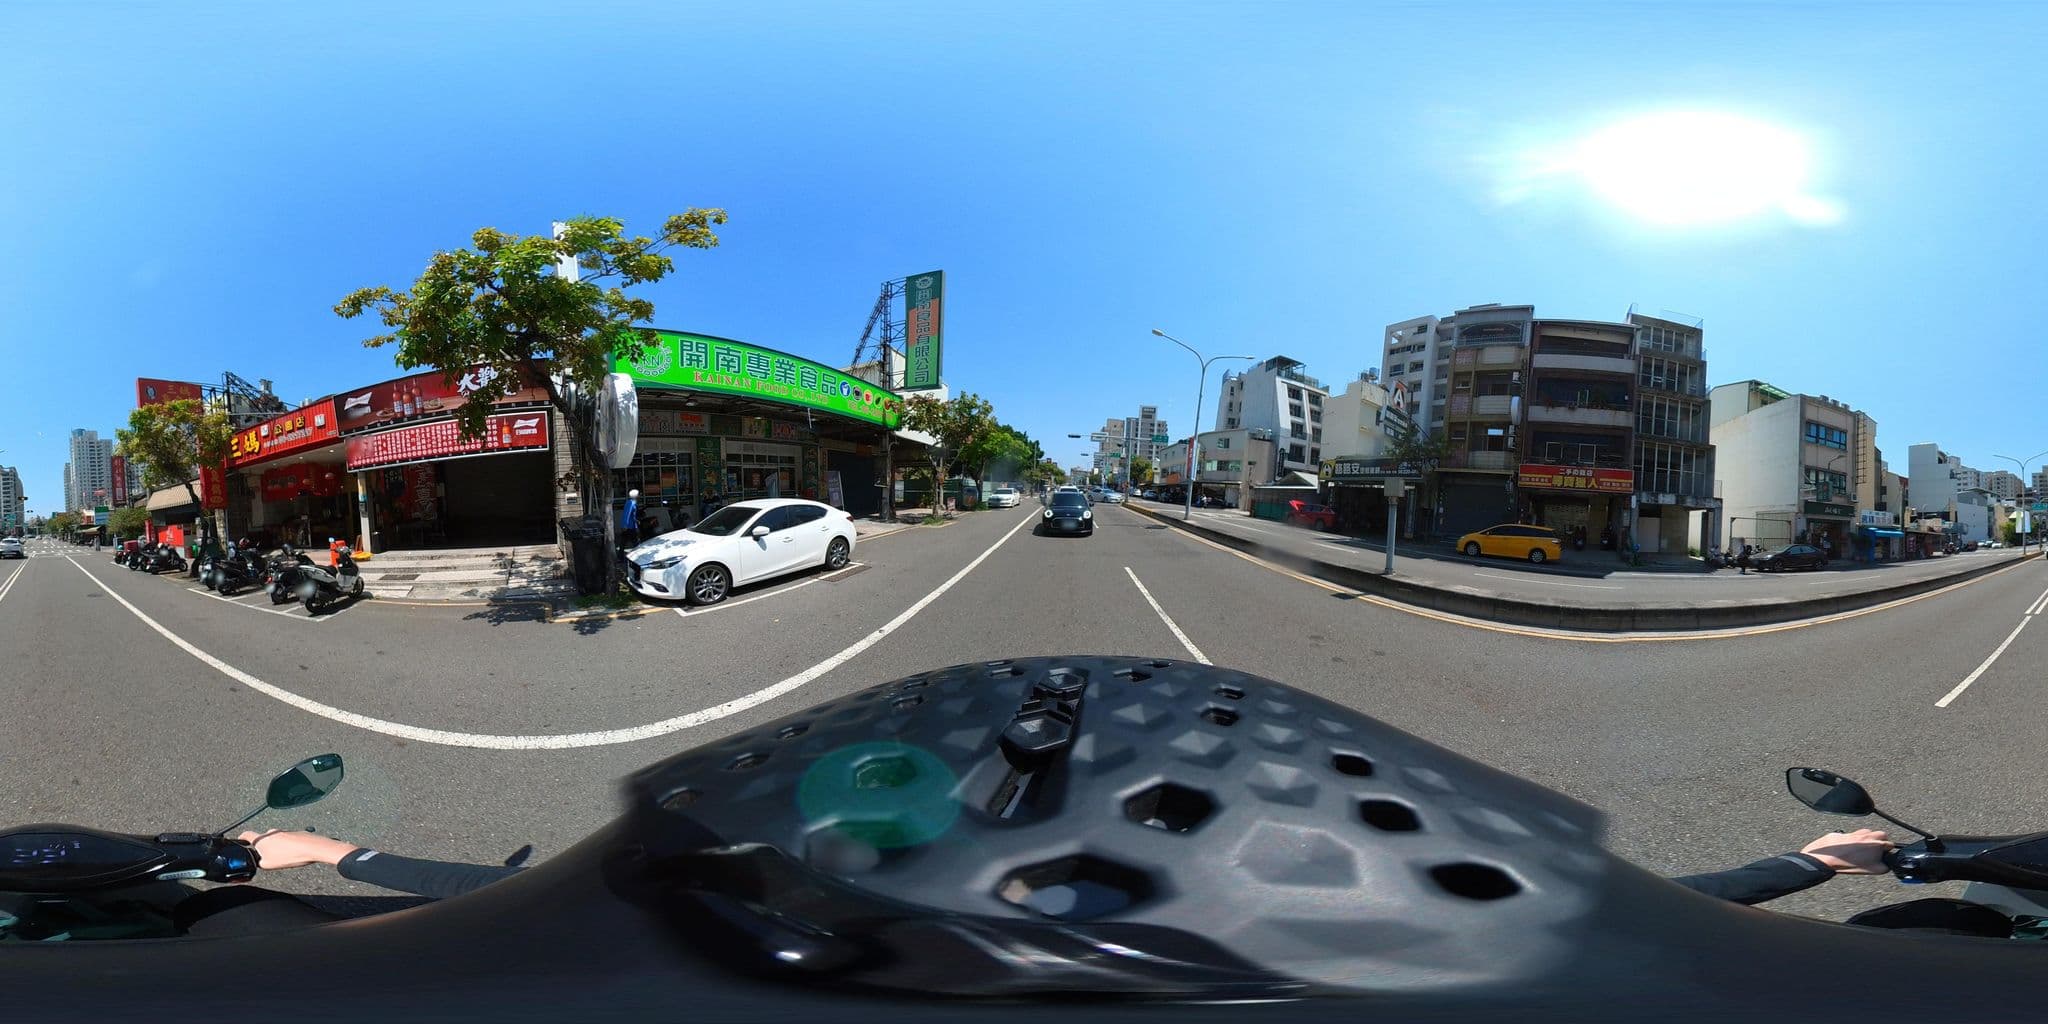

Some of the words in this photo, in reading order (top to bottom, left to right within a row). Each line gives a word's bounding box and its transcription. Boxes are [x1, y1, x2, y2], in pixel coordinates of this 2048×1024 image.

[679, 338, 837, 397] 開南專業食品
[694, 371, 751, 388] KAINAN
[756, 380, 789, 397] FOOD
[231, 430, 260, 458] 三媽
